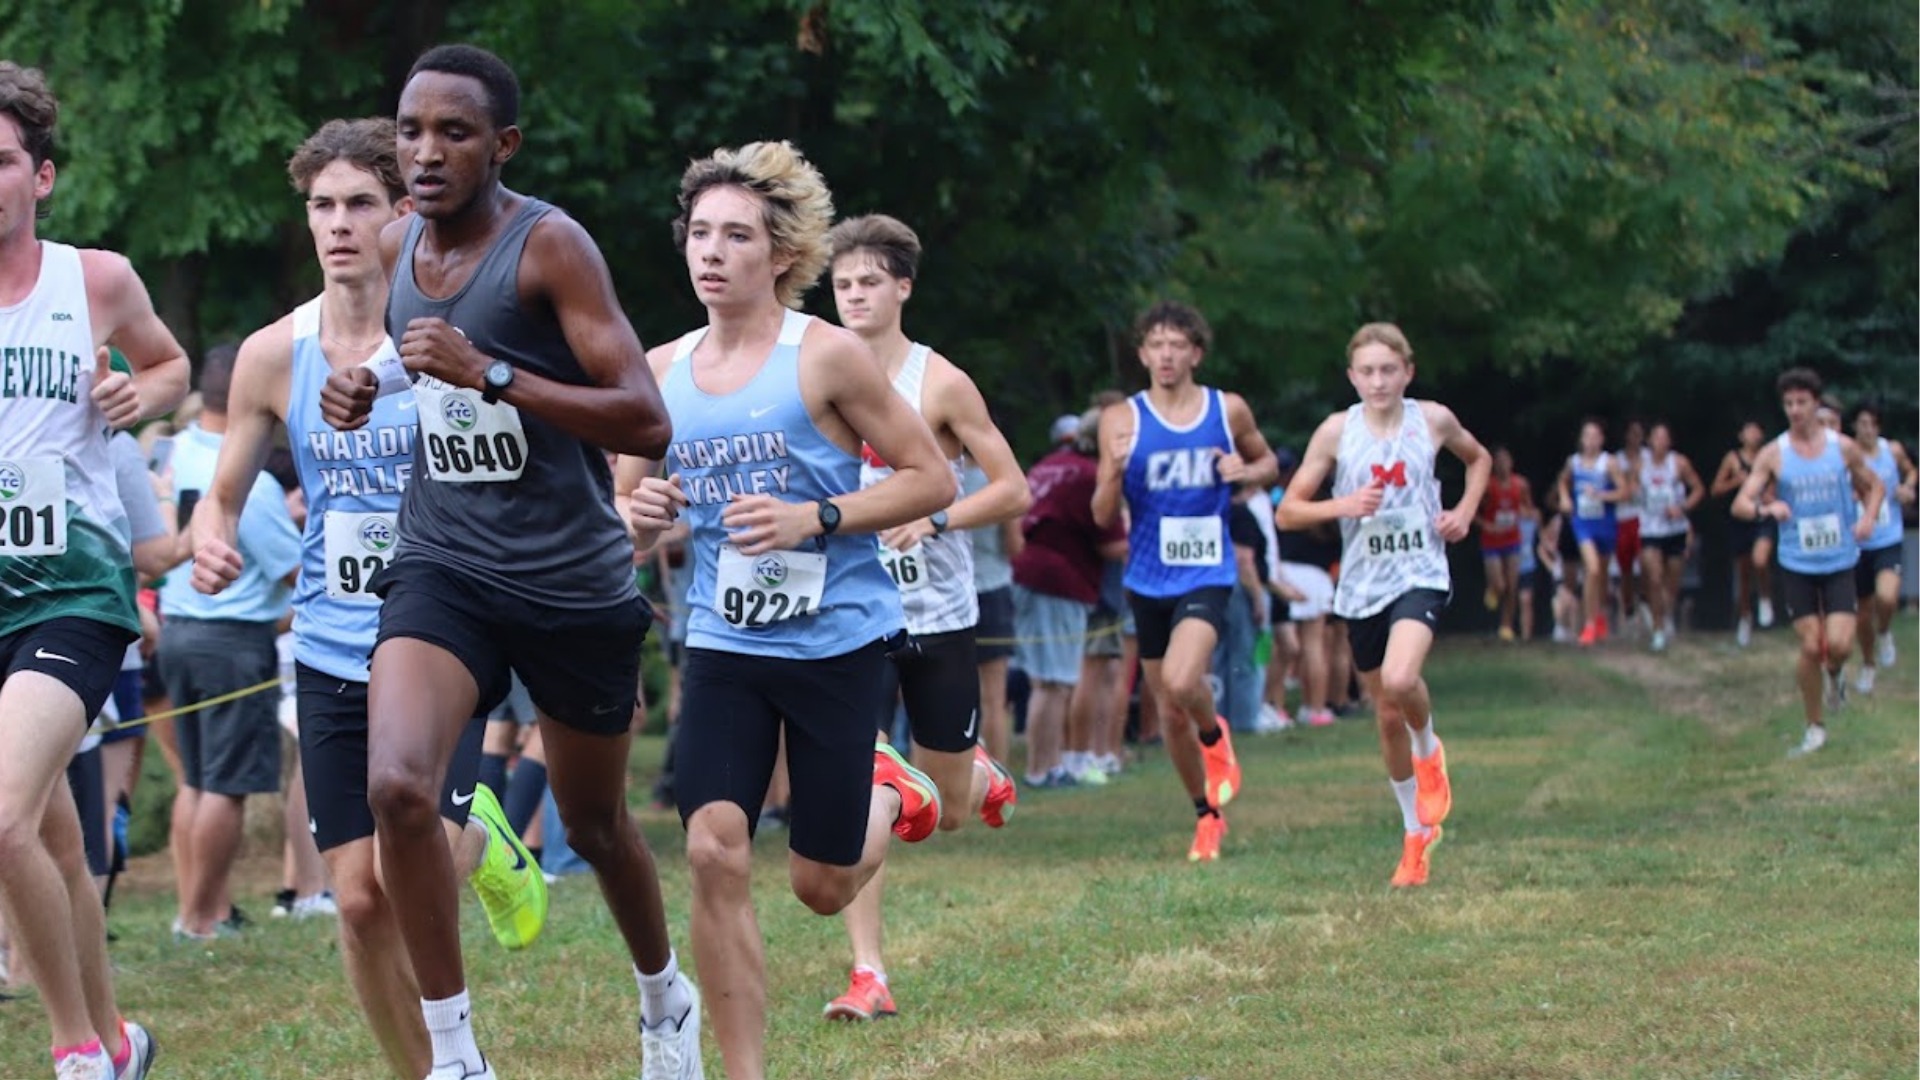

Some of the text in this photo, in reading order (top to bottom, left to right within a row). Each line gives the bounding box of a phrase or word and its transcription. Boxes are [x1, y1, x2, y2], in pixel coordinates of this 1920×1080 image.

[0, 347, 80, 404] EVILLE
[445, 408, 472, 418] KTC
[428, 432, 523, 474] 9640
[672, 430, 788, 469] HARDIN
[685, 464, 790, 505] VALLEY
[1146, 447, 1216, 491] CAK
[1371, 461, 1406, 488] M
[363, 531, 389, 540] KTC
[1166, 541, 1216, 559] 9034
[1369, 529, 1423, 555] 9444
[338, 554, 392, 594] 92
[757, 565, 783, 578] KTC
